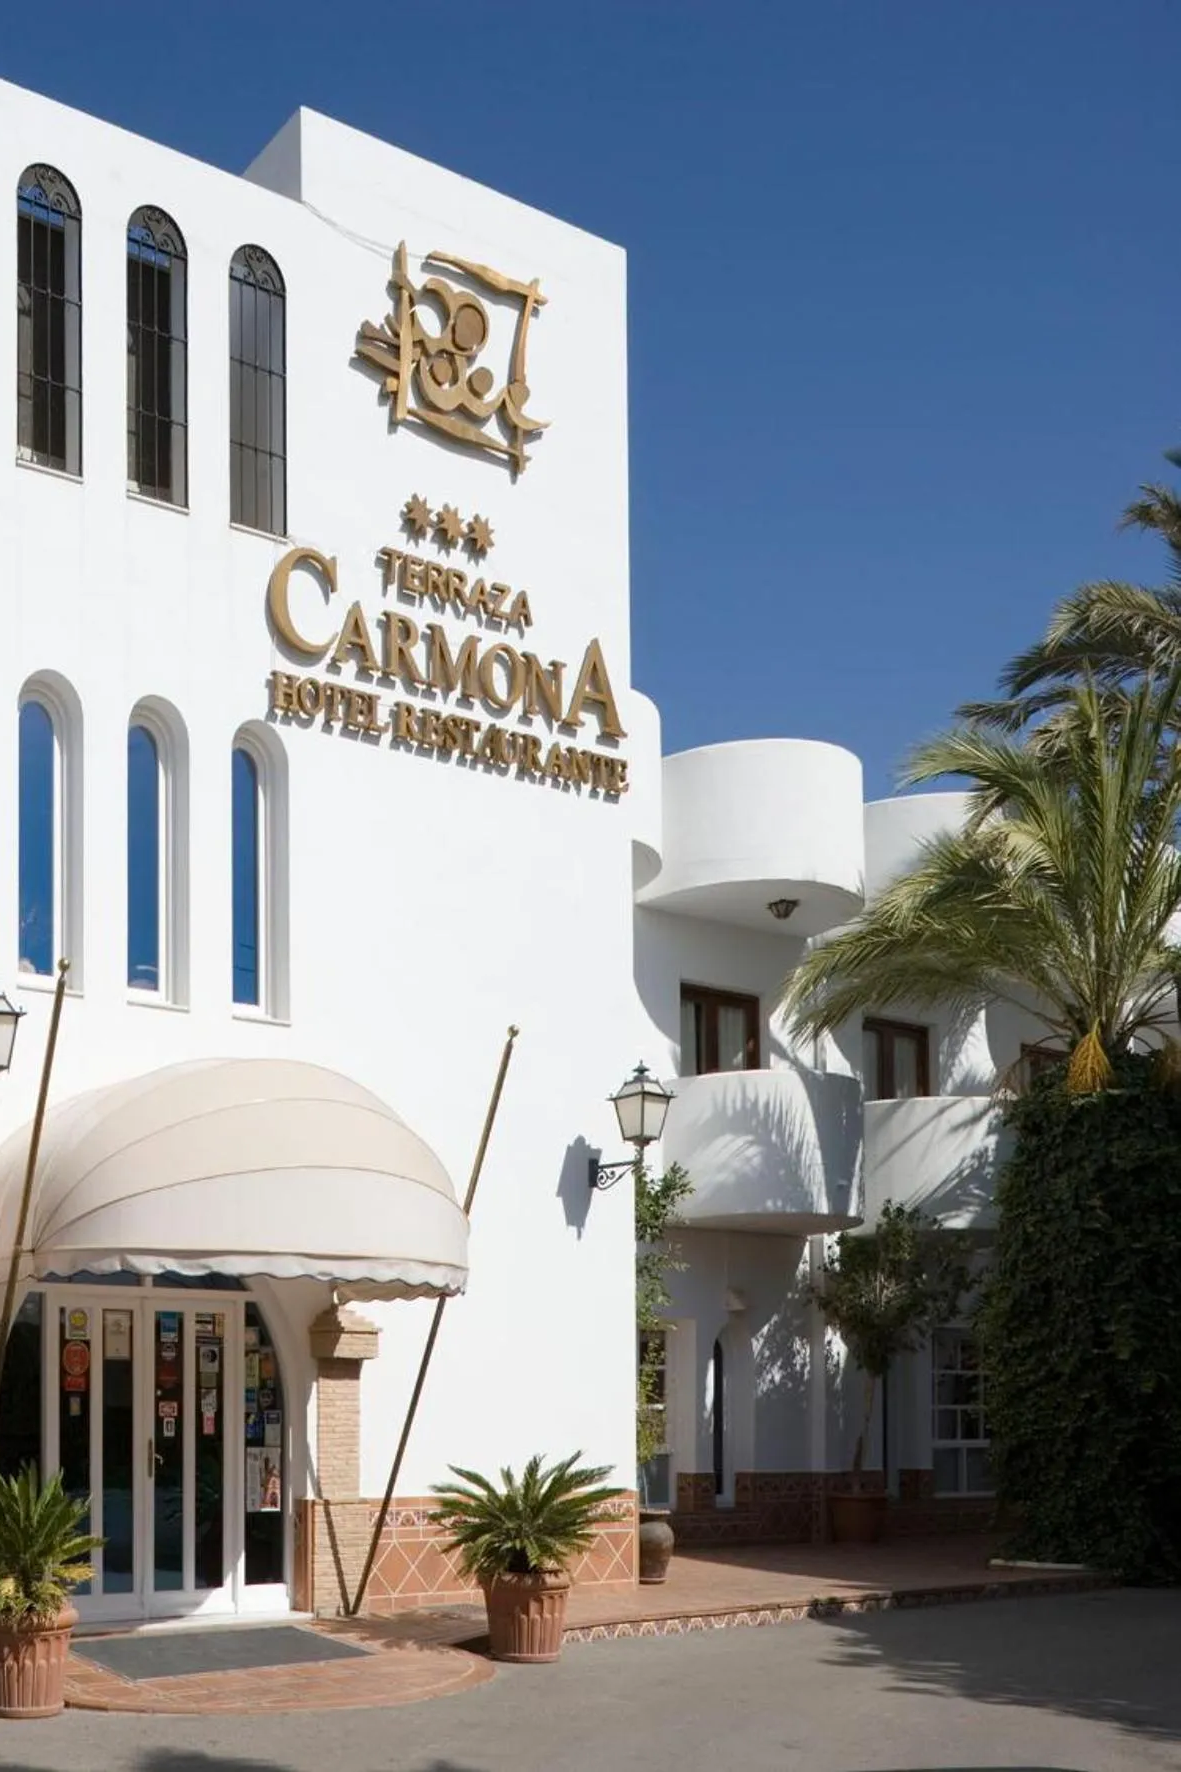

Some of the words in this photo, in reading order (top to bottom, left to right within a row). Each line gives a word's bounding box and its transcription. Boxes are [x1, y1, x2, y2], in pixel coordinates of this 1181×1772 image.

[269, 547, 627, 738] CARMONA
[381, 547, 532, 627] TERRAZA
[271, 671, 389, 733] HOTEL
[394, 701, 629, 794] RESTAURANTE
